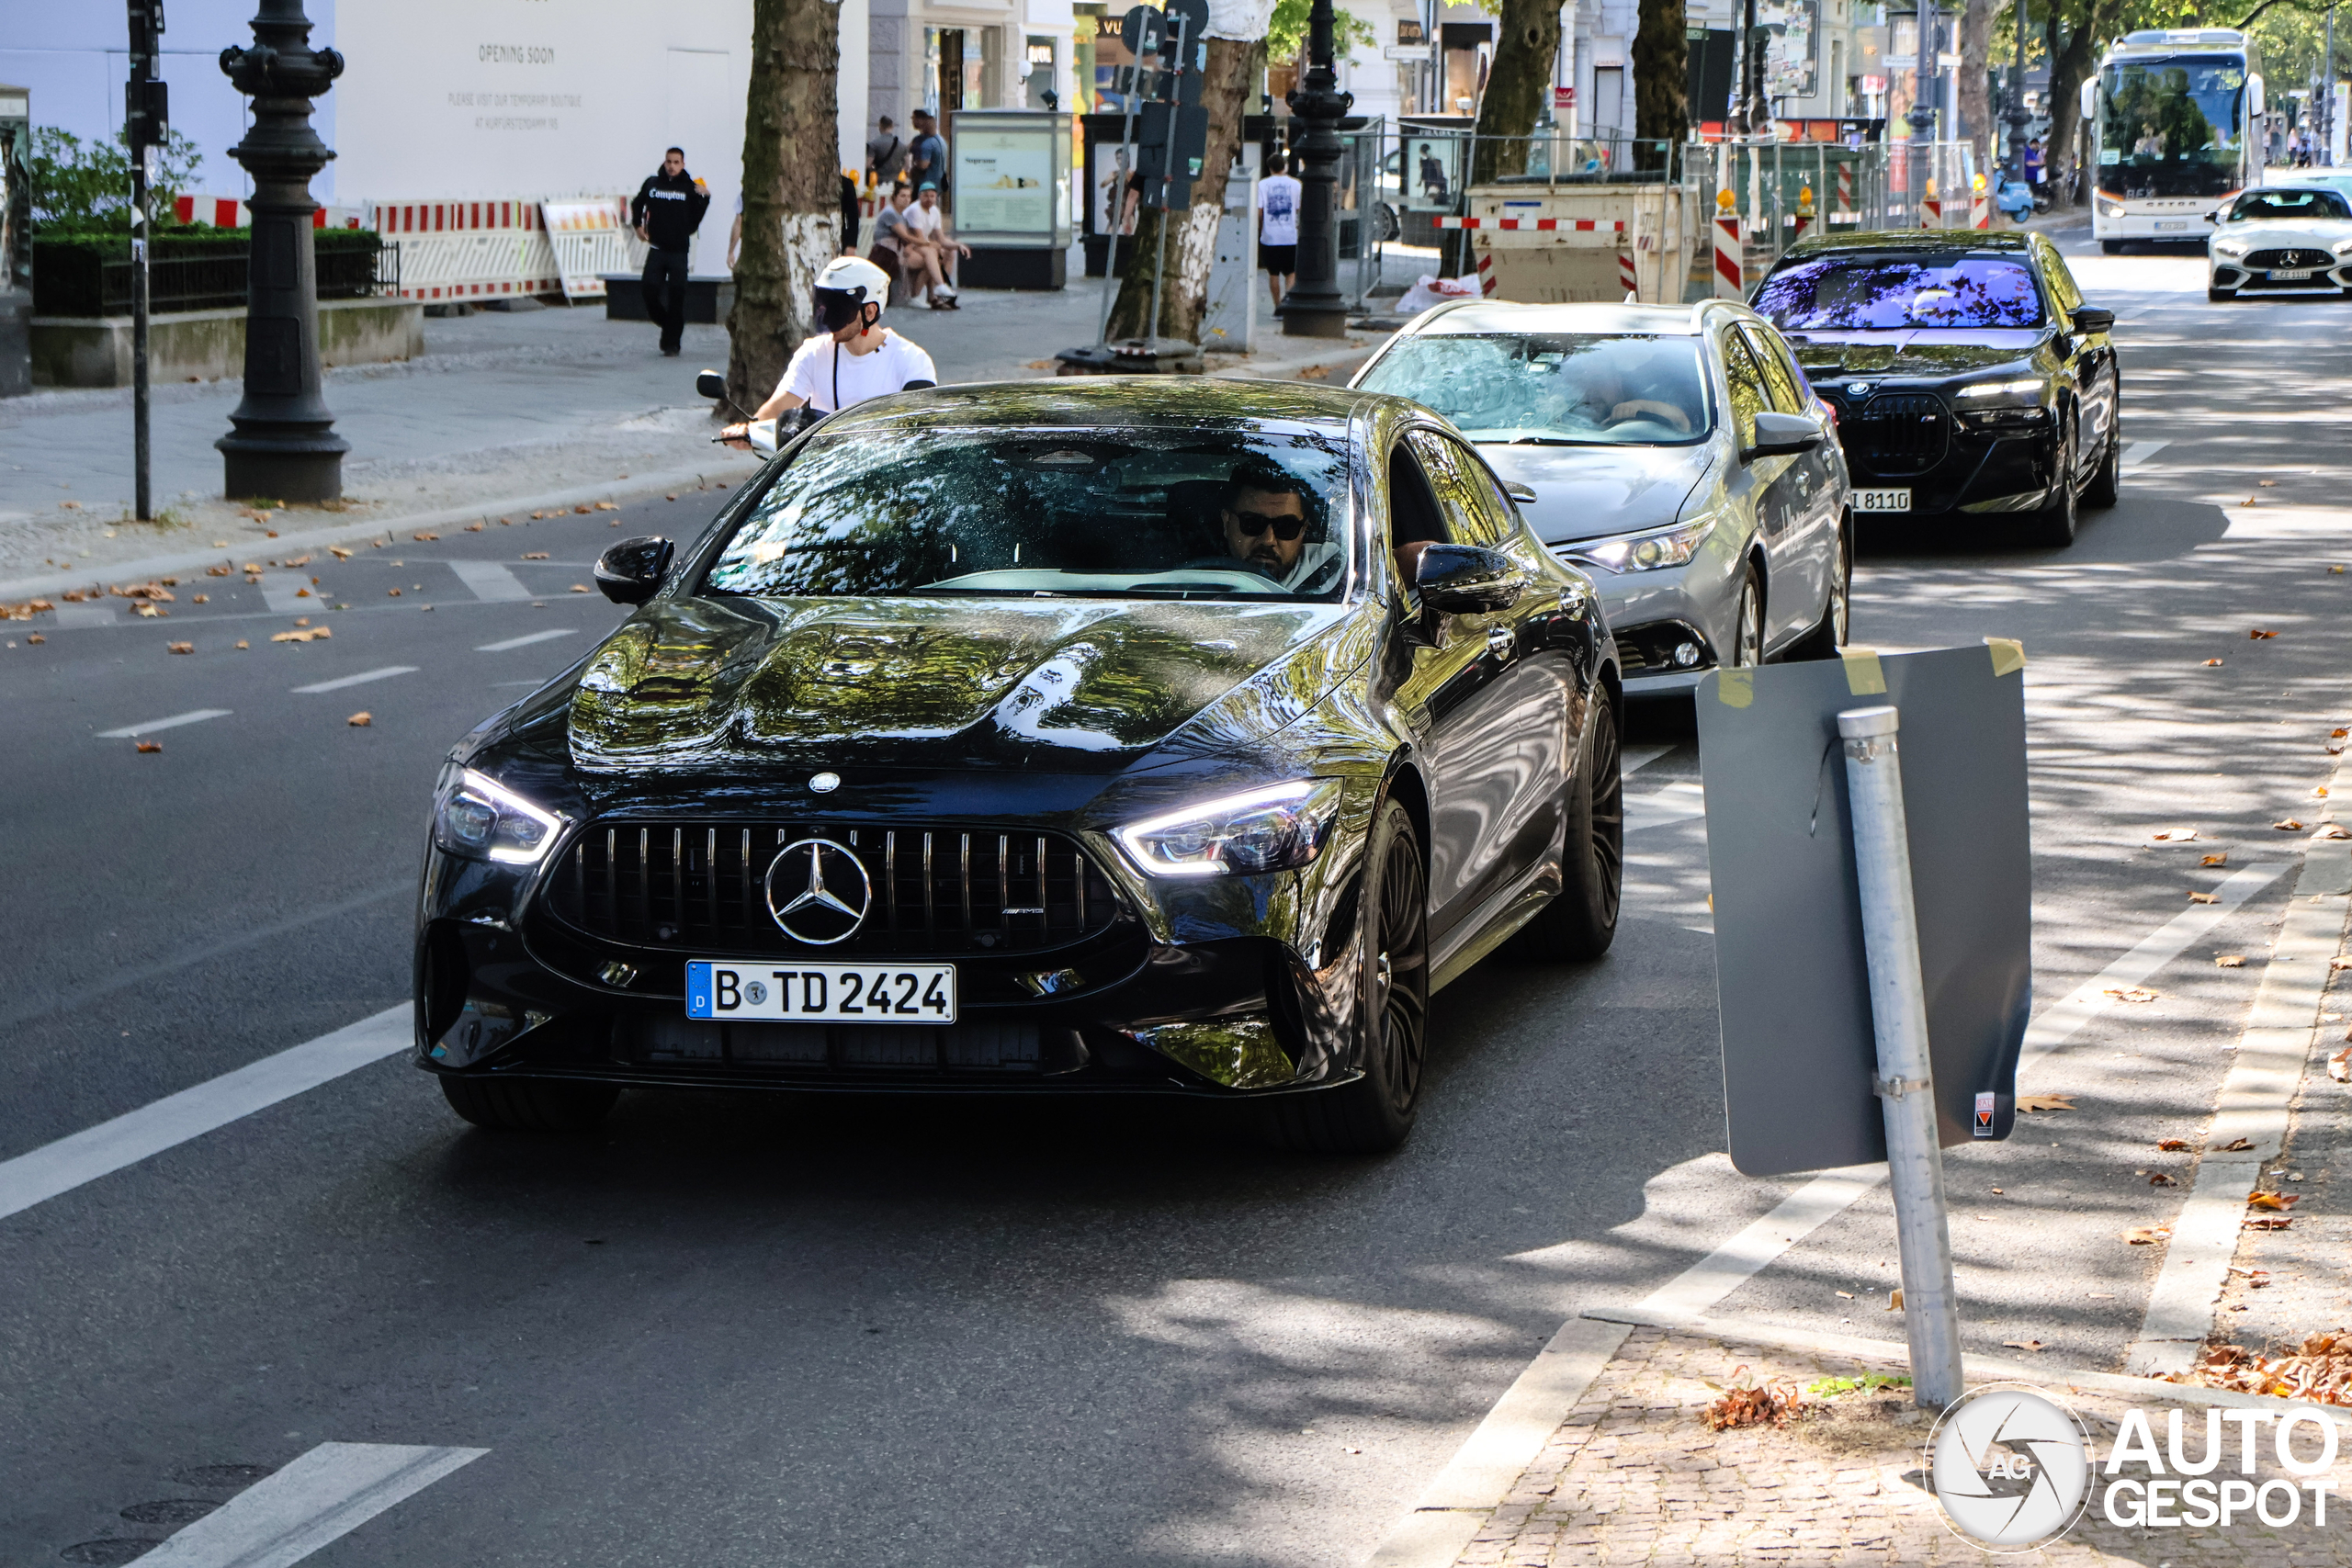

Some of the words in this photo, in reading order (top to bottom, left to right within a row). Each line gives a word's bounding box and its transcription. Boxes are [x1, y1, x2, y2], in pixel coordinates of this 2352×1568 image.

[479, 44, 524, 63] OPENING
[527, 47, 554, 64] SOON
[448, 93, 474, 107] PLEASE
[477, 94, 492, 107] VISIT
[494, 94, 508, 107] OUR
[510, 94, 548, 107] TEMPORARY
[550, 95, 582, 107] BOUTIQUE
[475, 118, 483, 129] AT
[649, 187, 687, 201] Compton
[1865, 492, 1908, 510] 8110
[717, 970, 741, 1010] B
[773, 971, 828, 1013] TD
[839, 972, 947, 1015] 2424
[695, 996, 705, 1008] D
